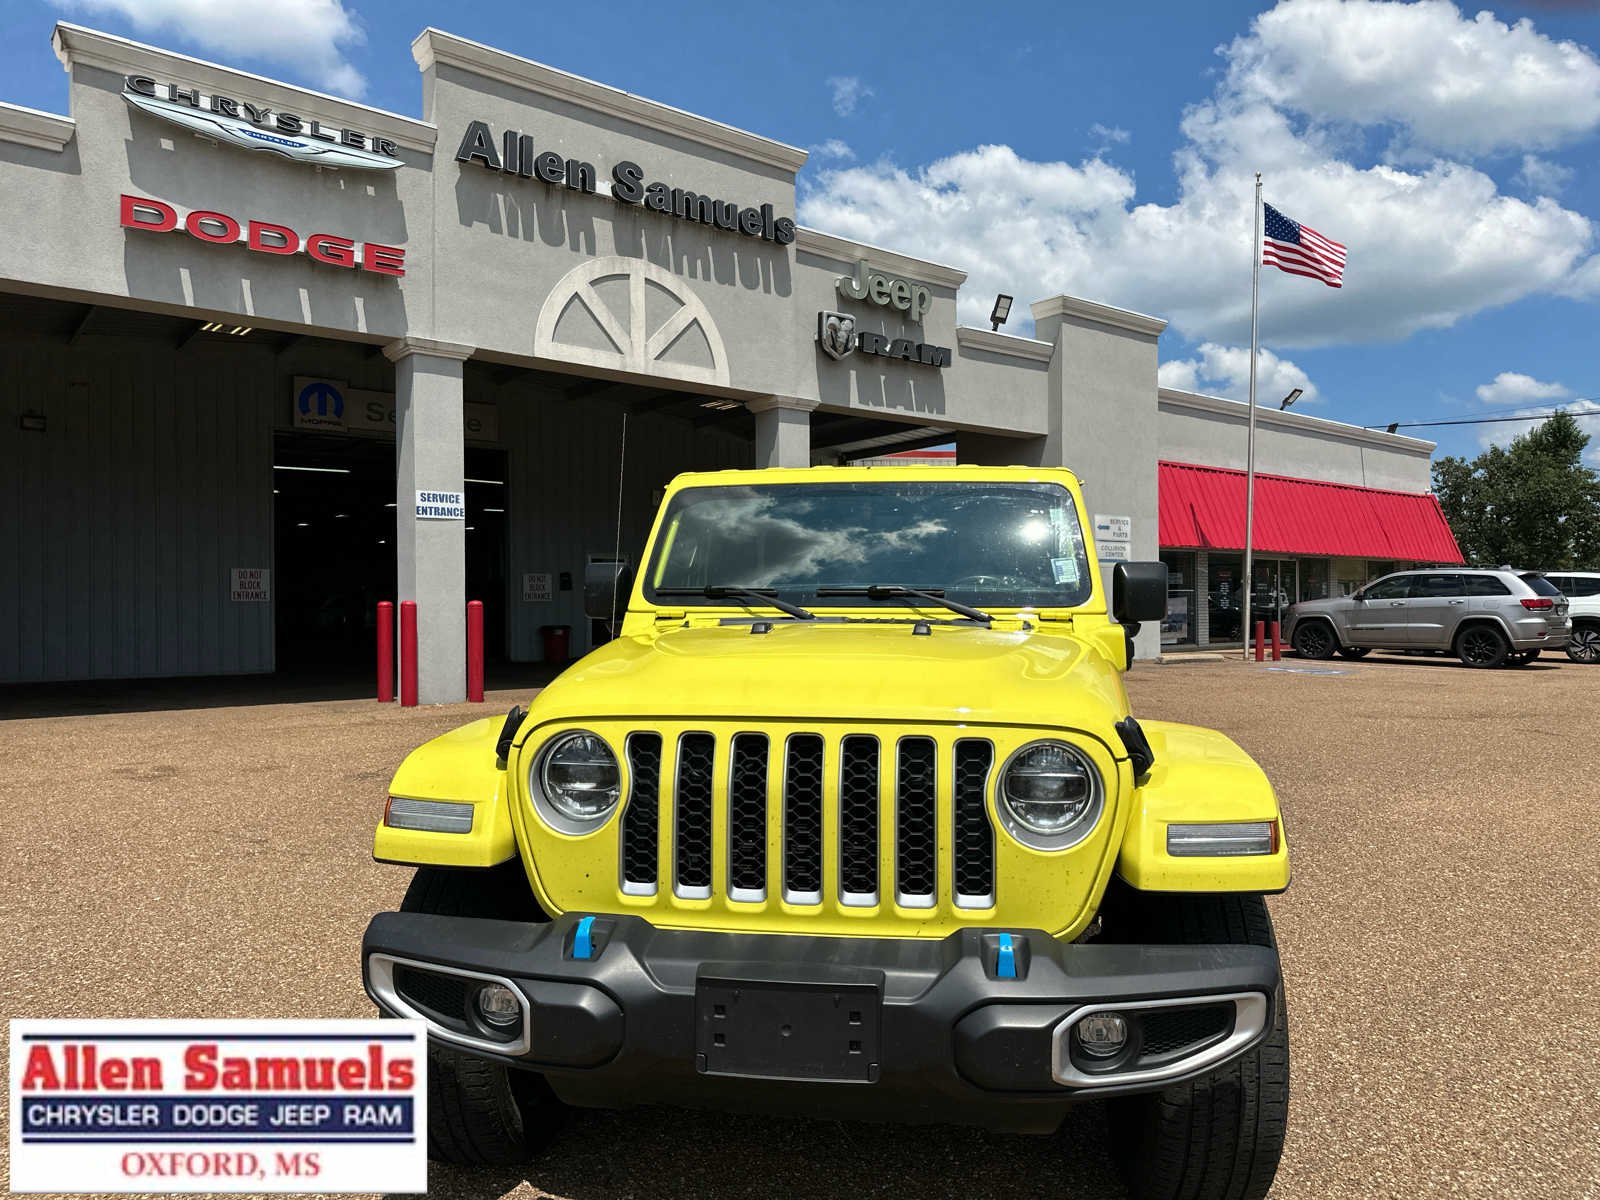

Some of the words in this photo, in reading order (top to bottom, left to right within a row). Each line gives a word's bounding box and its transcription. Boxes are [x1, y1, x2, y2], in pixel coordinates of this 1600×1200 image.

[125, 75, 400, 156] CHRYSLER
[455, 120, 597, 193] Allen
[611, 160, 796, 245] Samuels
[120, 193, 405, 277] DODGE
[834, 259, 932, 322] Jeep
[858, 331, 952, 368] RAM
[420, 492, 461, 504] SERVICE
[416, 506, 465, 517] ENTRANCE
[238, 570, 248, 579] DO
[249, 570, 262, 579] NOT
[239, 580, 262, 590] BLOCK
[233, 591, 267, 600] ENTRANCE
